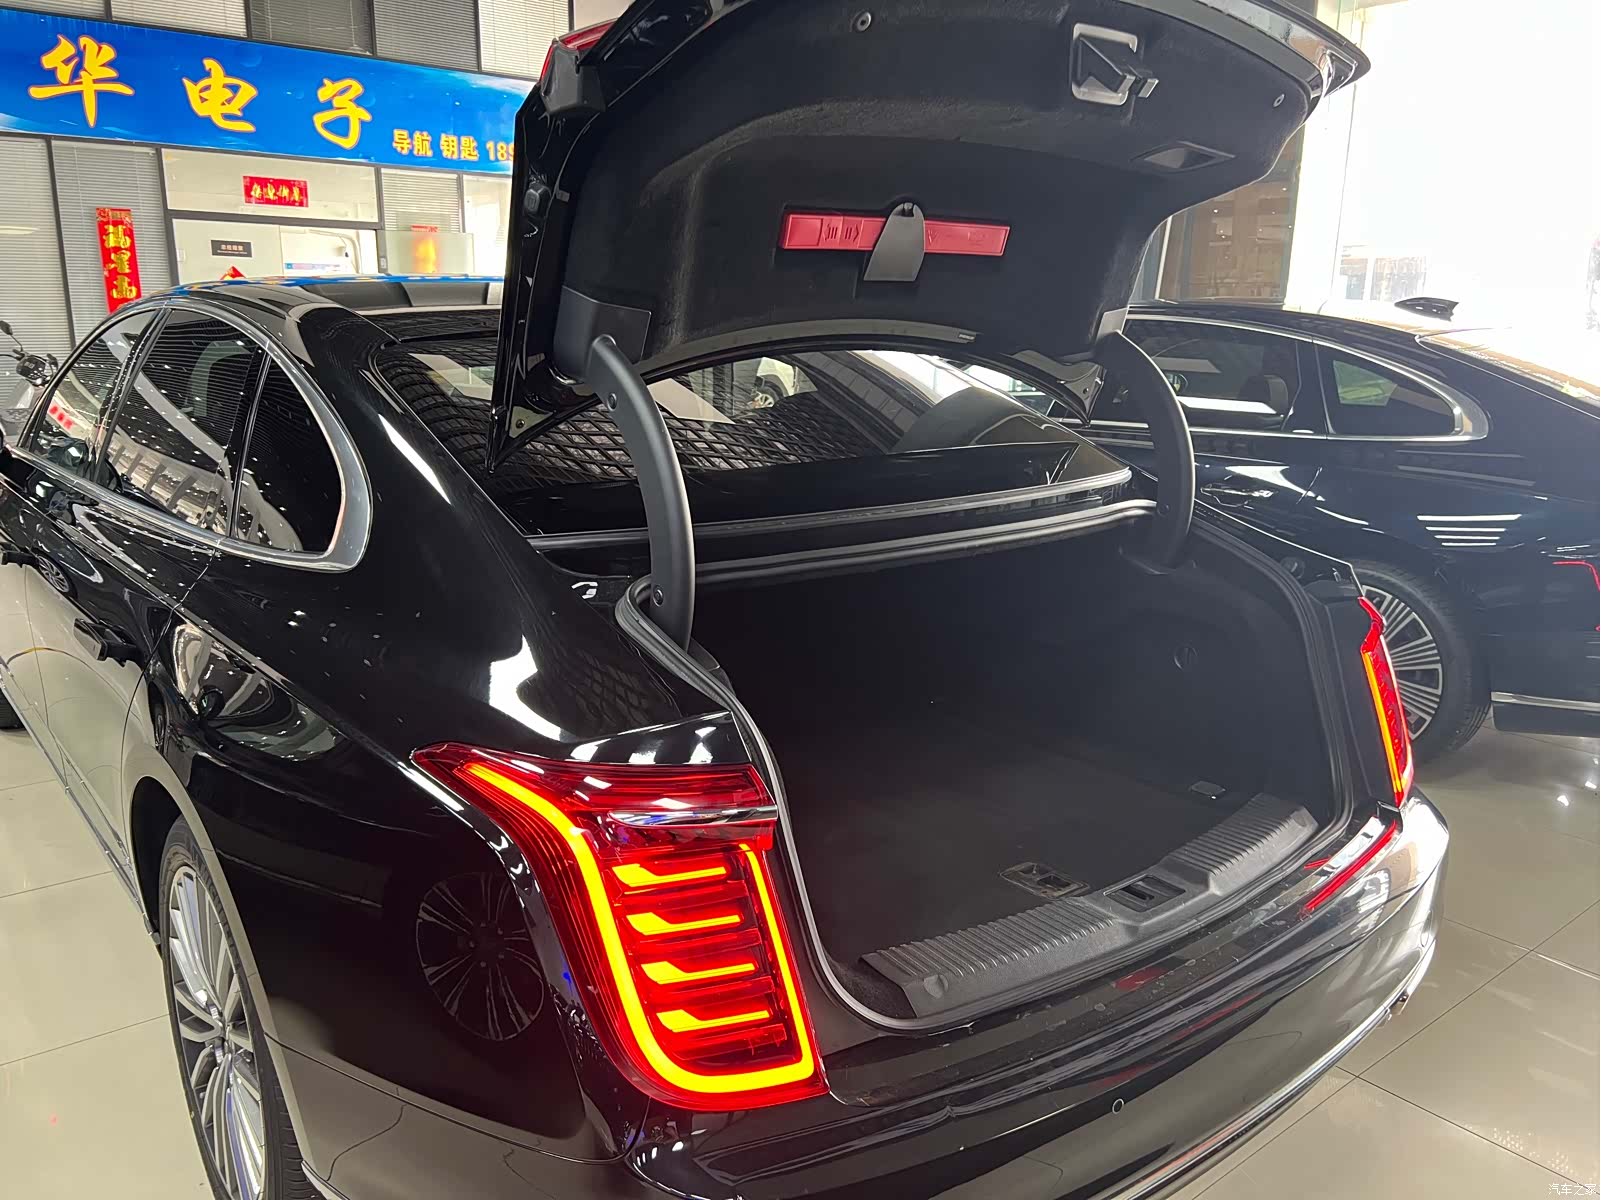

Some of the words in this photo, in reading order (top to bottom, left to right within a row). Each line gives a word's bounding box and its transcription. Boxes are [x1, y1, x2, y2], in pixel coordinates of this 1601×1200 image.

[28, 34, 372, 149] 华电子
[392, 128, 433, 157] 导航
[440, 133, 480, 161] 钥匙
